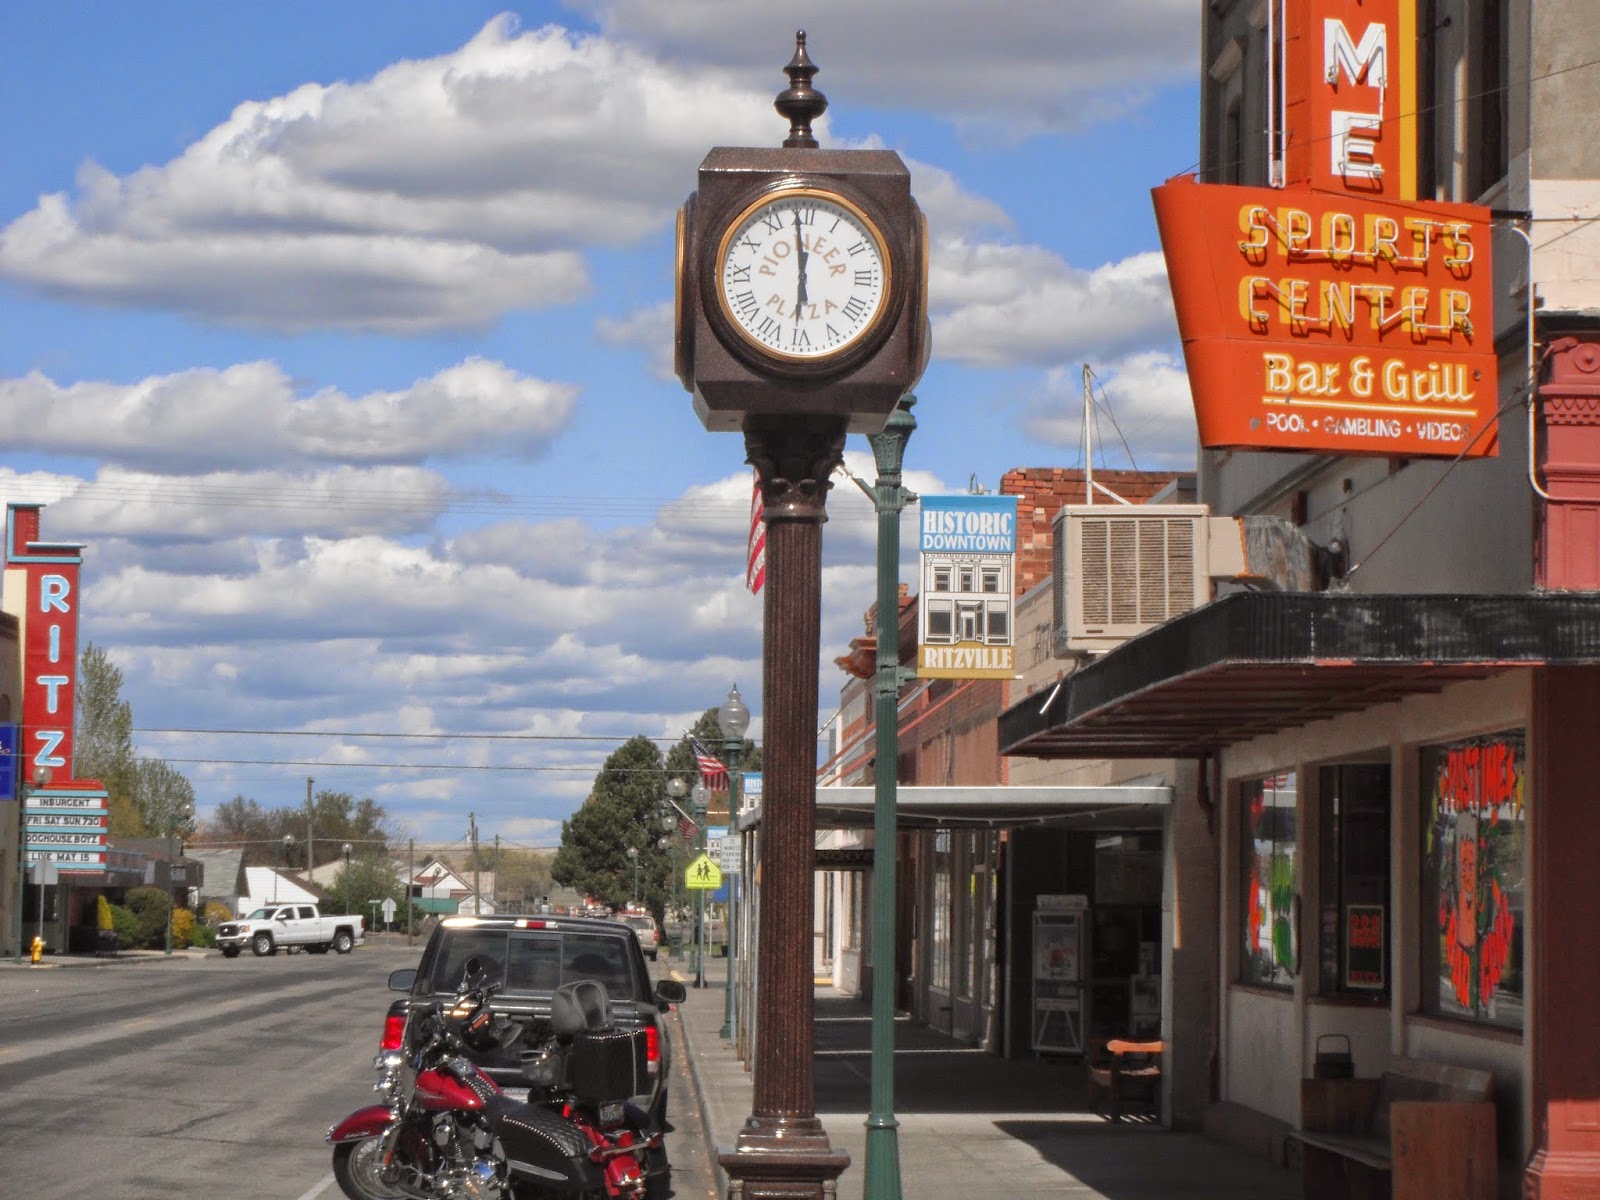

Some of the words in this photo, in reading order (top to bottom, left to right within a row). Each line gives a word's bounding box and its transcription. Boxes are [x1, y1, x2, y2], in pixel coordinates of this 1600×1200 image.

[761, 213, 784, 236] XI
[1238, 204, 1474, 267] SPORTS
[742, 234, 762, 255] X
[758, 232, 847, 278] PIONEER
[847, 241, 867, 257] II
[733, 263, 751, 284] IX
[854, 269, 872, 287] III
[736, 290, 760, 323] VIII
[765, 293, 839, 321] PLAZA
[1238, 275, 1474, 336] CENTER
[758, 316, 782, 342] VII
[792, 328, 811, 346] VI
[826, 322, 841, 341] V
[1262, 352, 1342, 398] Bar
[1349, 356, 1376, 397] &
[1382, 358, 1476, 402] Grill
[1267, 412, 1310, 433] POOL
[1323, 416, 1402, 438] GAMBLING
[923, 510, 1012, 536] HISTORIC
[924, 534, 1011, 550] DOWNTOWN
[924, 647, 1012, 669] RITZVILLE
[34, 574, 71, 767] RITZ
[39, 798, 90, 807] INSURGENT
[27, 816, 42, 825] FRI
[44, 816, 62, 825] SAT
[63, 817, 81, 826] SUN
[83, 817, 99, 826] 730
[26, 834, 72, 843] DOGHOUSE
[74, 835, 97, 844] BOYZ
[31, 852, 52, 860] LIVE
[57, 853, 77, 862] MAY
[80, 853, 90, 862] 15
